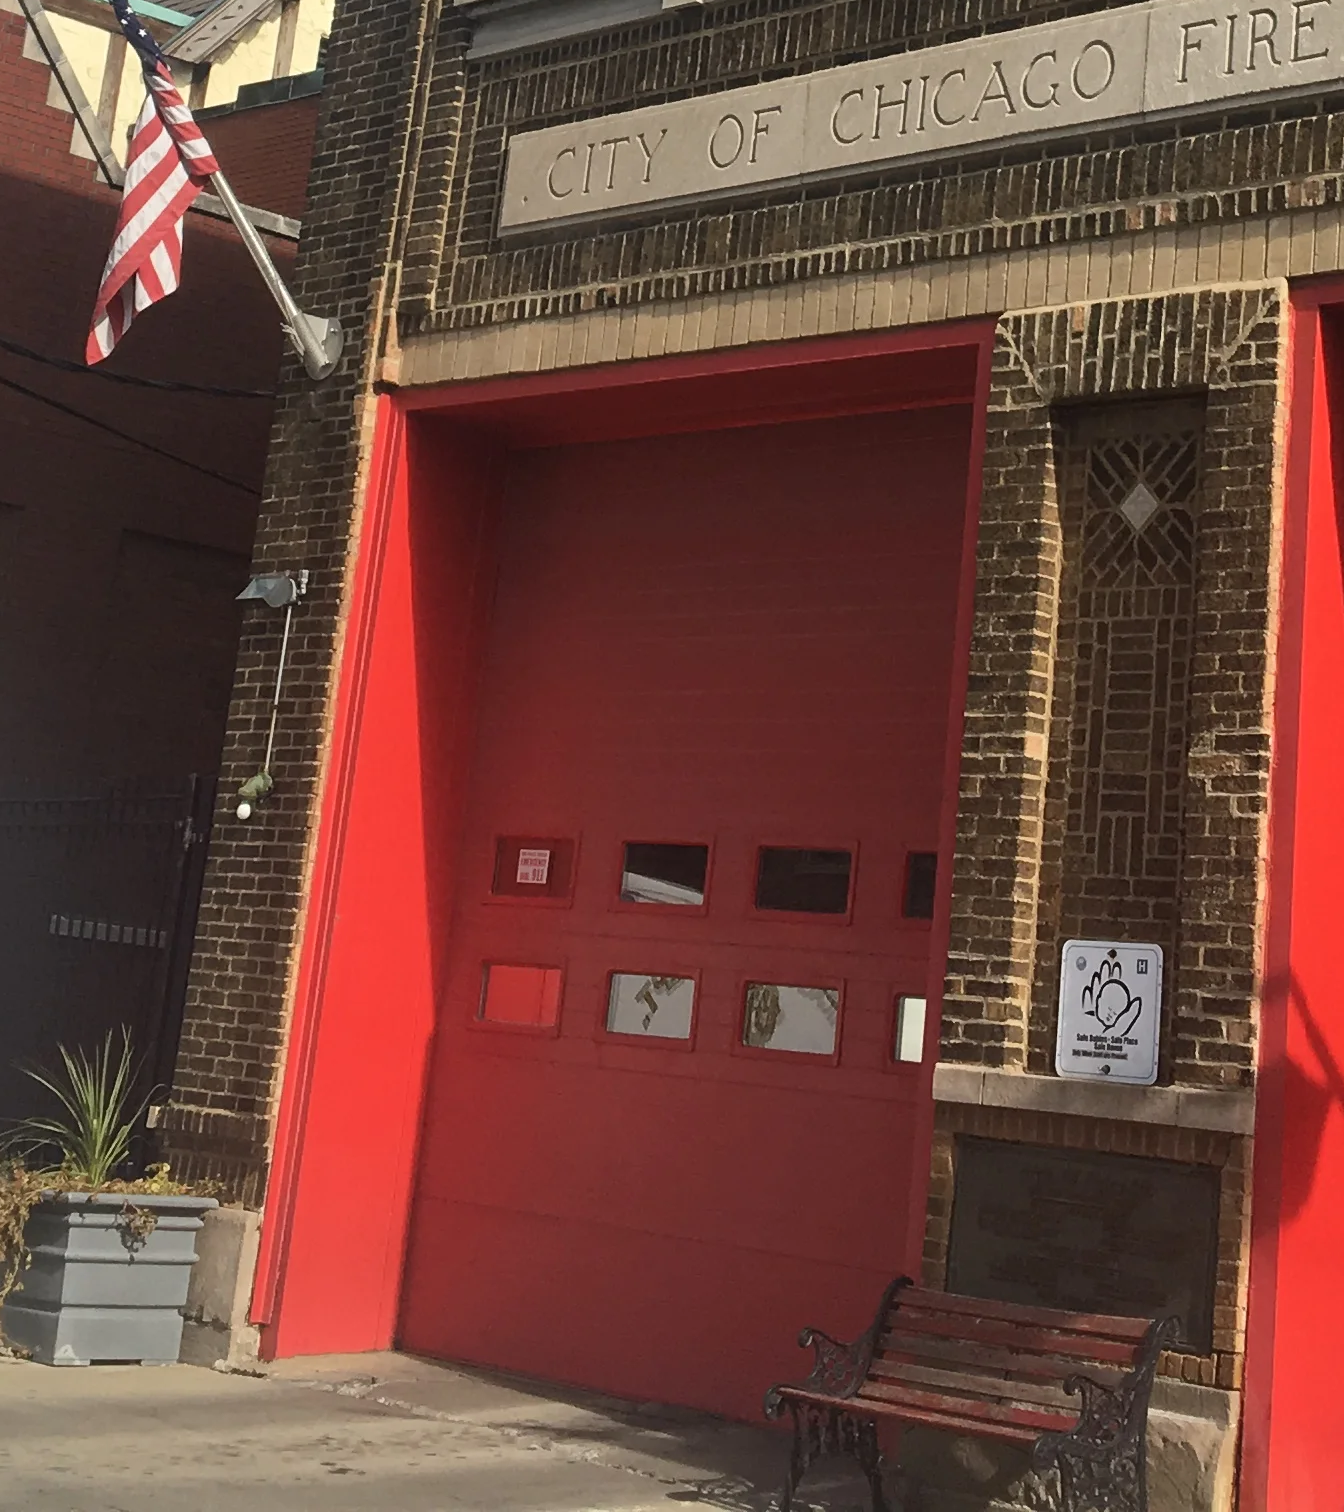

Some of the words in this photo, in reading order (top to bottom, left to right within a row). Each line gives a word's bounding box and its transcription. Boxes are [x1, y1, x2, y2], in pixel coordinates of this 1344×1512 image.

[546, 127, 668, 202] CITY
[707, 104, 783, 170] OF
[829, 39, 1116, 146] CHICAGO
